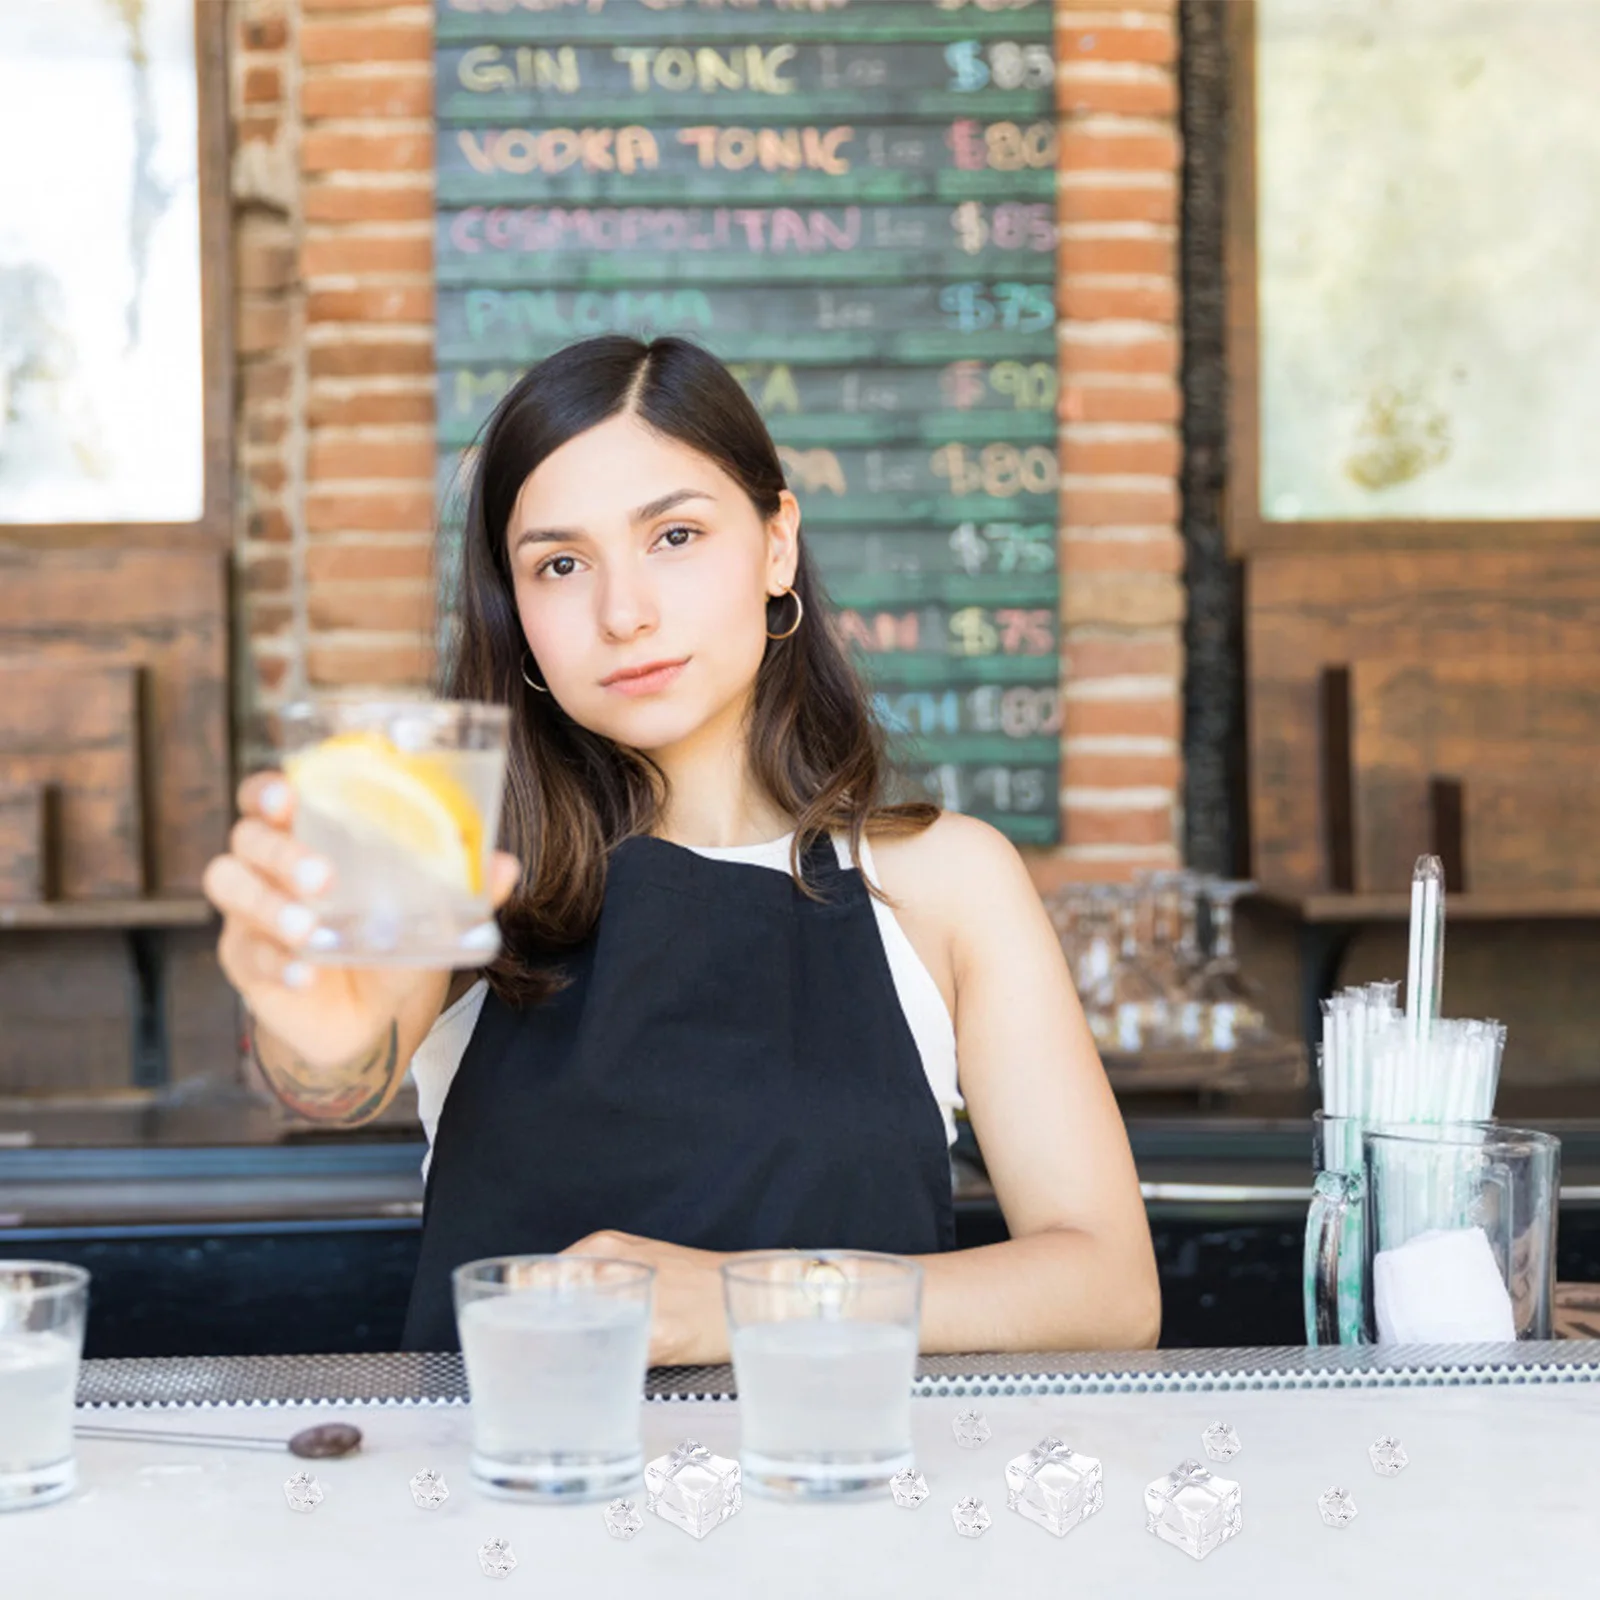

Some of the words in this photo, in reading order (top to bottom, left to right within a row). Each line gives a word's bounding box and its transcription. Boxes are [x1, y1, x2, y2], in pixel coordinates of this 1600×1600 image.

[458, 46, 580, 93] GIN
[613, 45, 796, 94] TONIC
[459, 126, 659, 175] VODKA
[678, 126, 855, 175] TONIC
